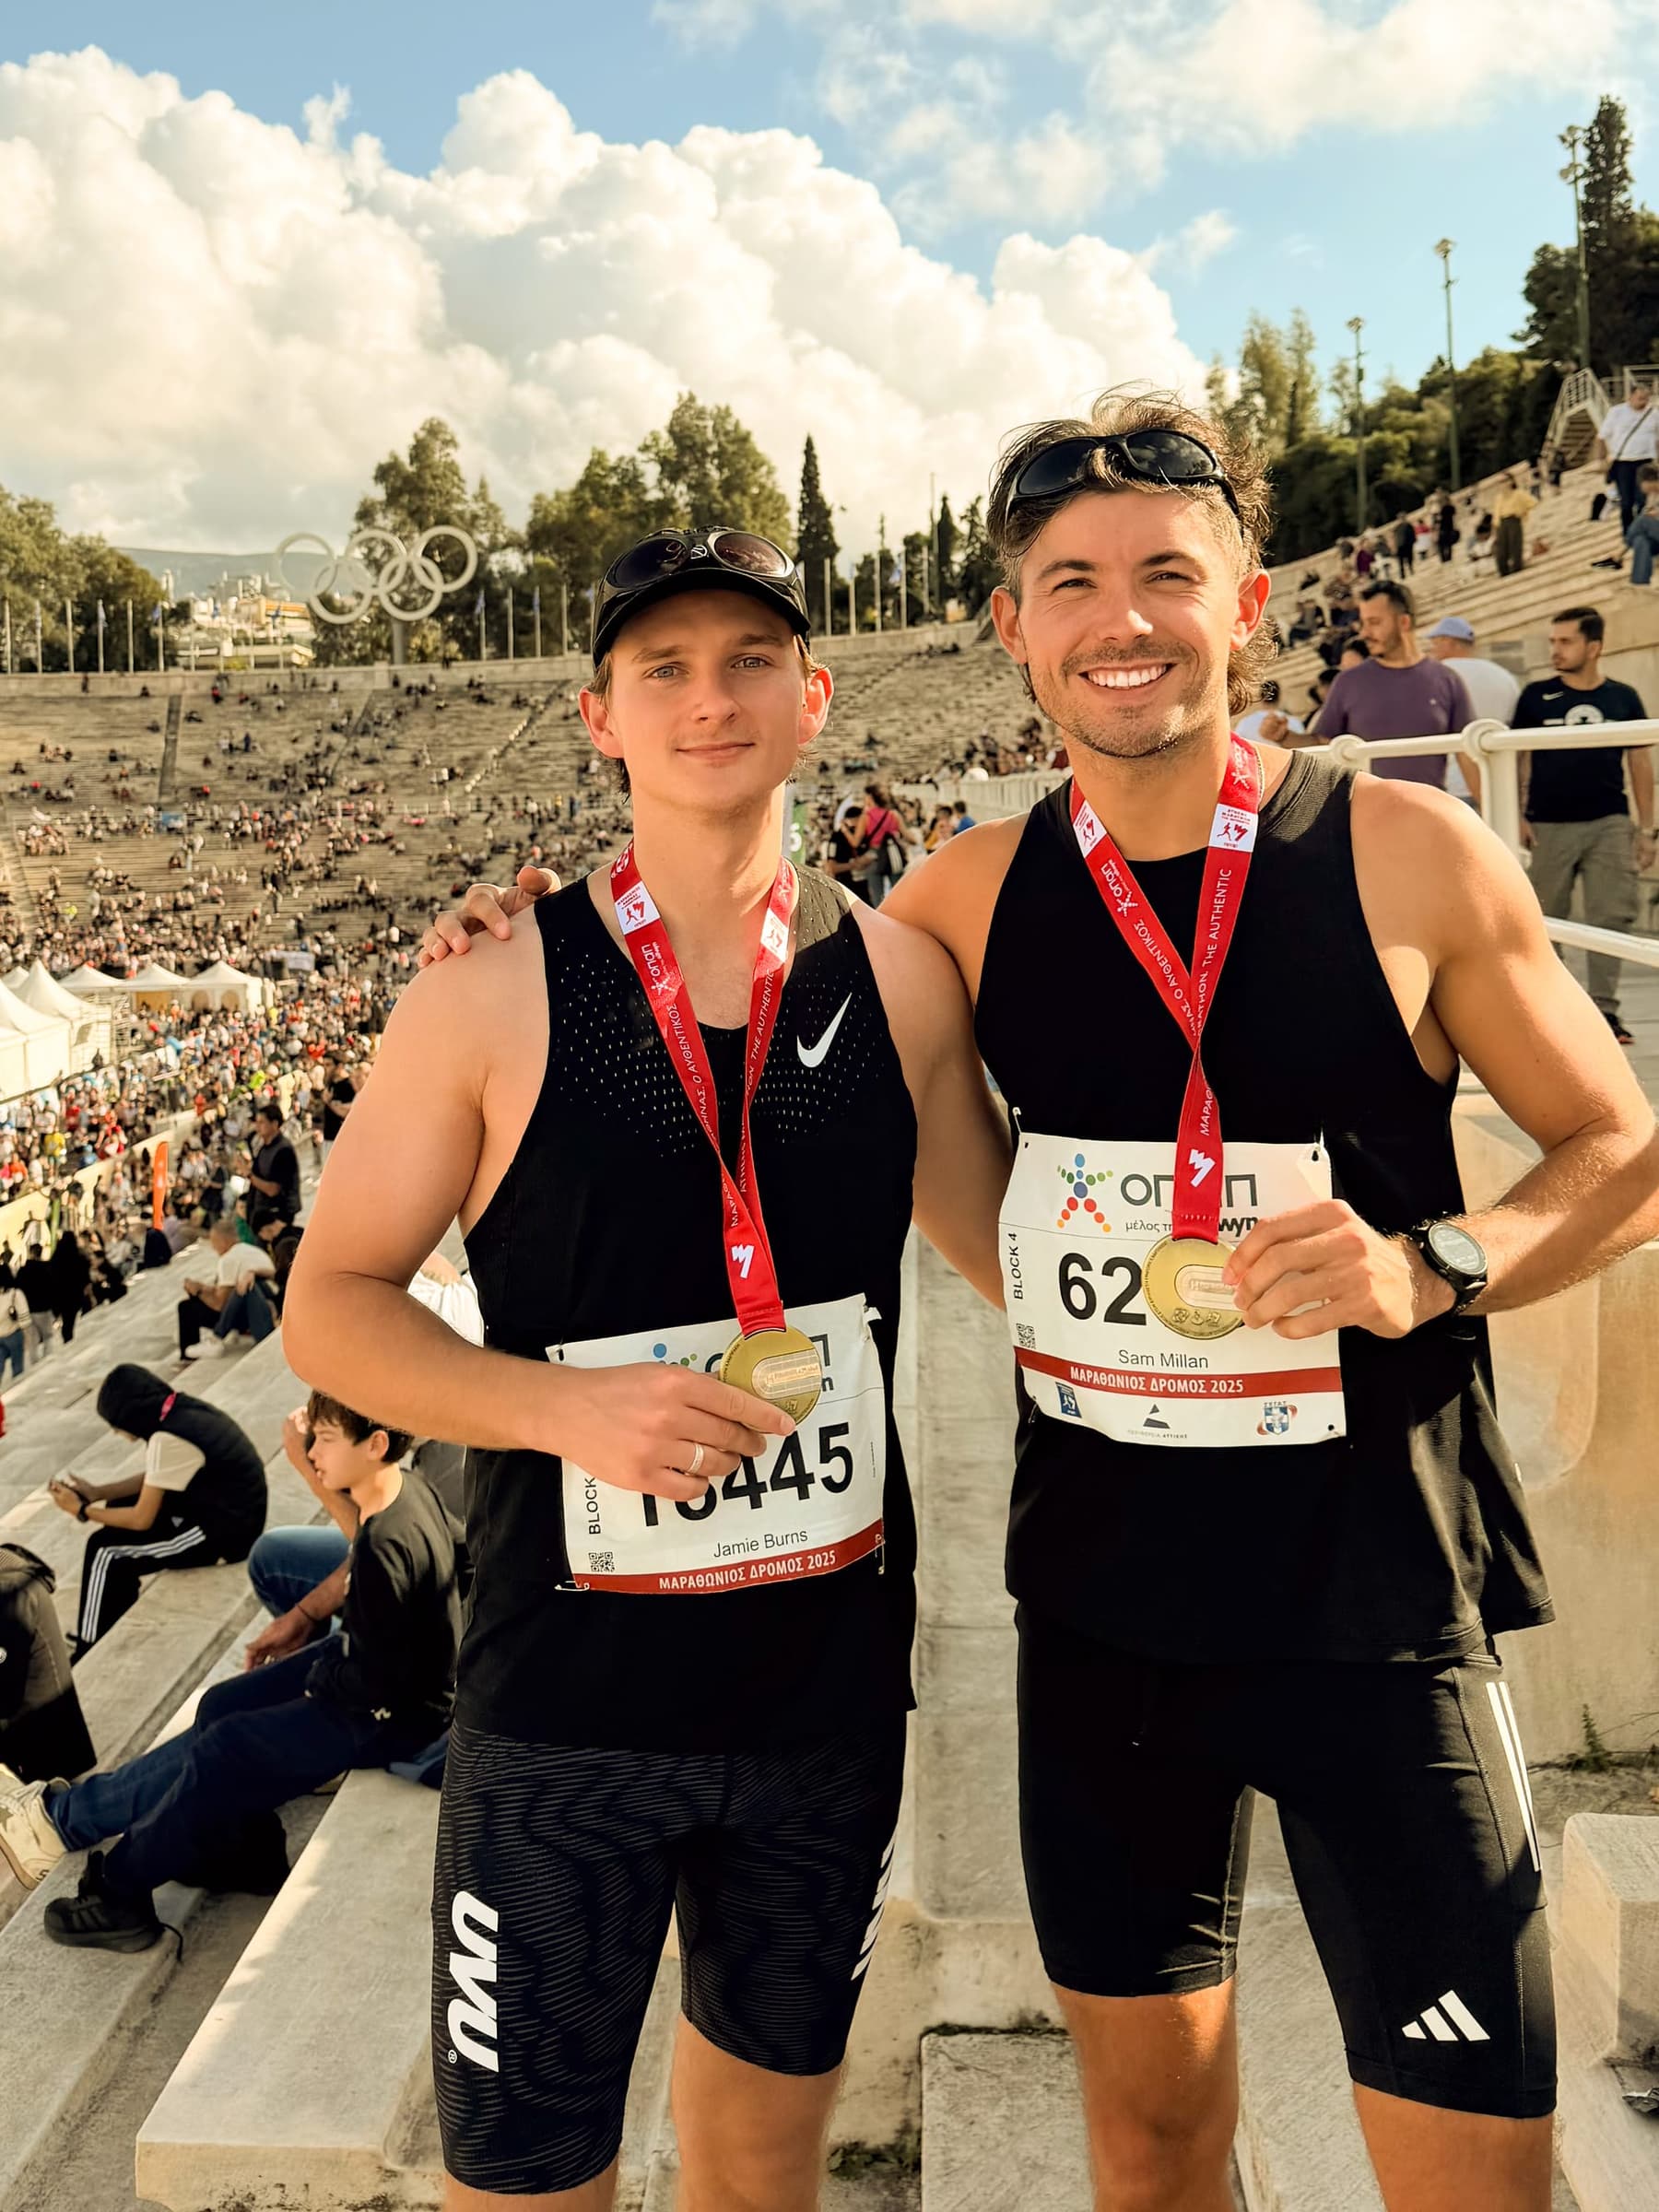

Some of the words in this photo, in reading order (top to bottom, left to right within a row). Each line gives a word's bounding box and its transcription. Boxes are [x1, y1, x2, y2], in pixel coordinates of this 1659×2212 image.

[1208, 868, 1233, 940] AUTHENTIC
[1202, 943, 1218, 968] THE
[755, 970, 776, 1034] AUTHENTIC
[751, 1035, 762, 1061] THE
[1200, 1087, 1214, 1136] ΜΑΡΑΘ
[1007, 1232, 1018, 1241] 4
[1125, 1219, 1160, 1233] μέλος
[1009, 1246, 1024, 1300] BLOCK
[1118, 1349, 1155, 1367] Sam
[1160, 1353, 1208, 1369] Millan
[1070, 1366, 1147, 1391] ΜΑΡΑΘΩΝΙΟΣ
[1150, 1378, 1207, 1394] ΔΡΟΜΟΣ
[1210, 1380, 1244, 1394] 2025
[584, 1477, 601, 1535] BLOCK
[713, 1537, 759, 1559] Jamie
[763, 1529, 808, 1550] Burns
[659, 1567, 746, 1590] ΜΑΡΑΘΩΝΙΟΣ
[749, 1557, 804, 1579] ΔΡΟΜΟΣ
[807, 1550, 837, 1571] 2025
